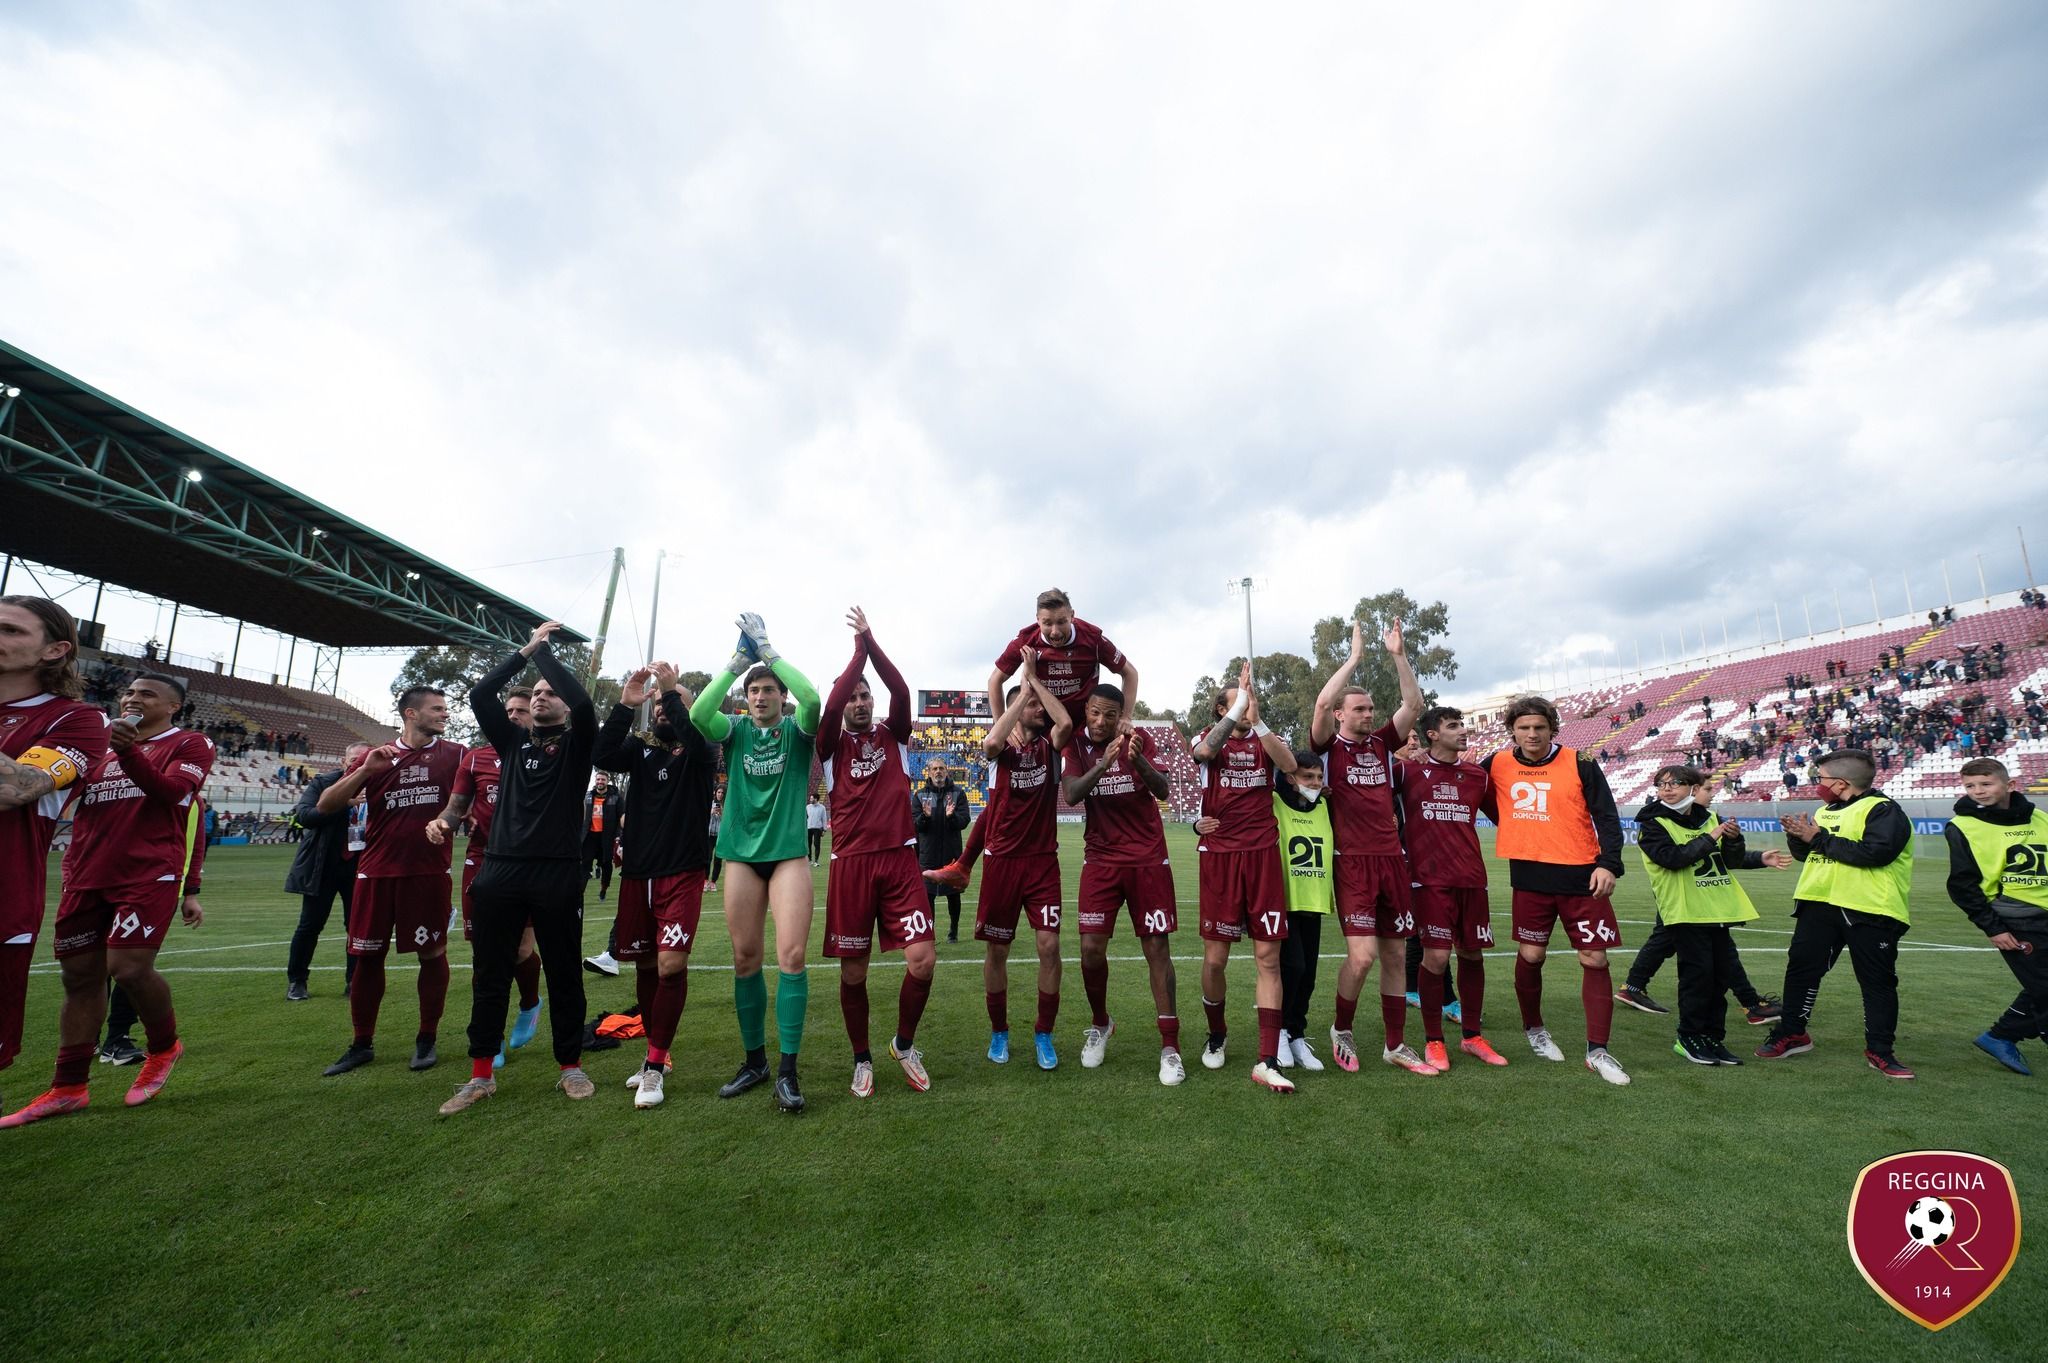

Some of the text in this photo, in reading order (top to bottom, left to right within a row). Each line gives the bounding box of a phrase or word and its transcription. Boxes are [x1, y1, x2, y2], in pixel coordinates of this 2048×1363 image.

[49, 758, 71, 777] C
[525, 758, 539, 770] 28
[658, 767, 669, 781] 16
[1421, 801, 1470, 813] Centroriparo
[1512, 812, 1551, 822] DOMOTEK
[899, 910, 927, 941] 30
[1040, 904, 1060, 928] 15
[1144, 909, 1168, 933] 90
[1260, 911, 1280, 936] 17
[414, 925, 430, 946] 8
